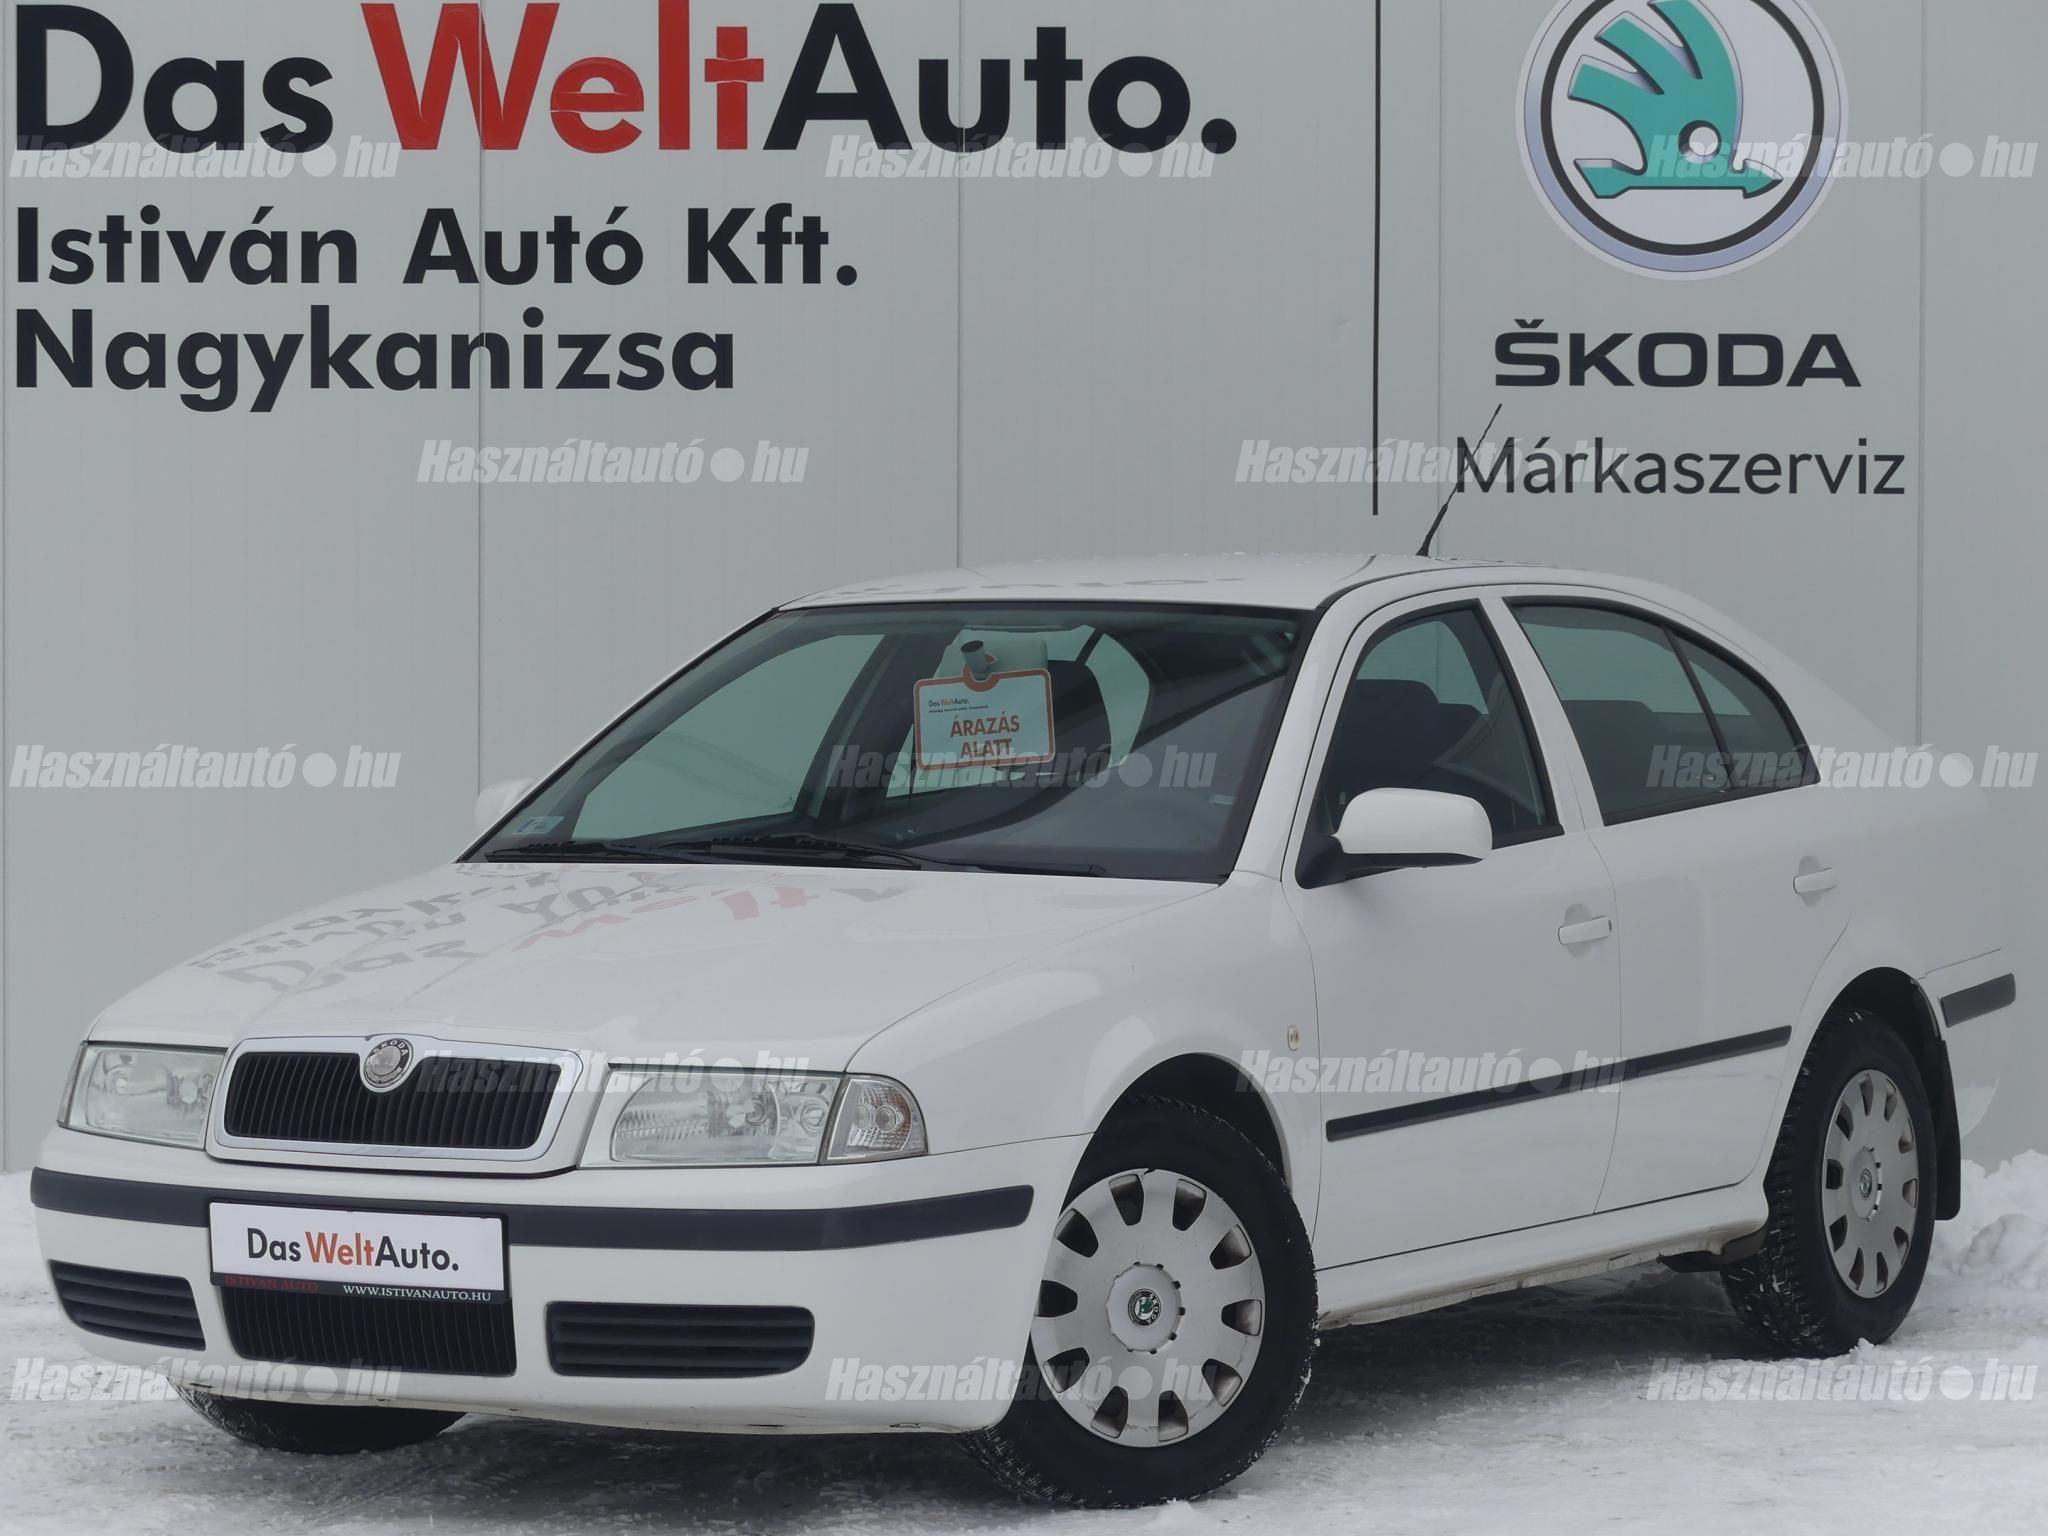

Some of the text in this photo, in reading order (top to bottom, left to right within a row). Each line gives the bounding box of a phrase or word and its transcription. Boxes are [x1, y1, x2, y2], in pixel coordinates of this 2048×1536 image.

[15, 3, 334, 154] Das
[16, 203, 858, 287] Istiván Autó Kft.
[16, 304, 734, 412] Nagykanizsa
[1494, 319, 1862, 388] ŠKODA
[1456, 436, 1906, 495] Márkaszerviz
[950, 711, 1020, 737] ÁRAZÁS
[960, 738, 1013, 758] ALATT
[247, 1227, 459, 1272] Das WeltAuto.
[343, 1285, 492, 1301] WWW.ISTIVANAUTO.HU
